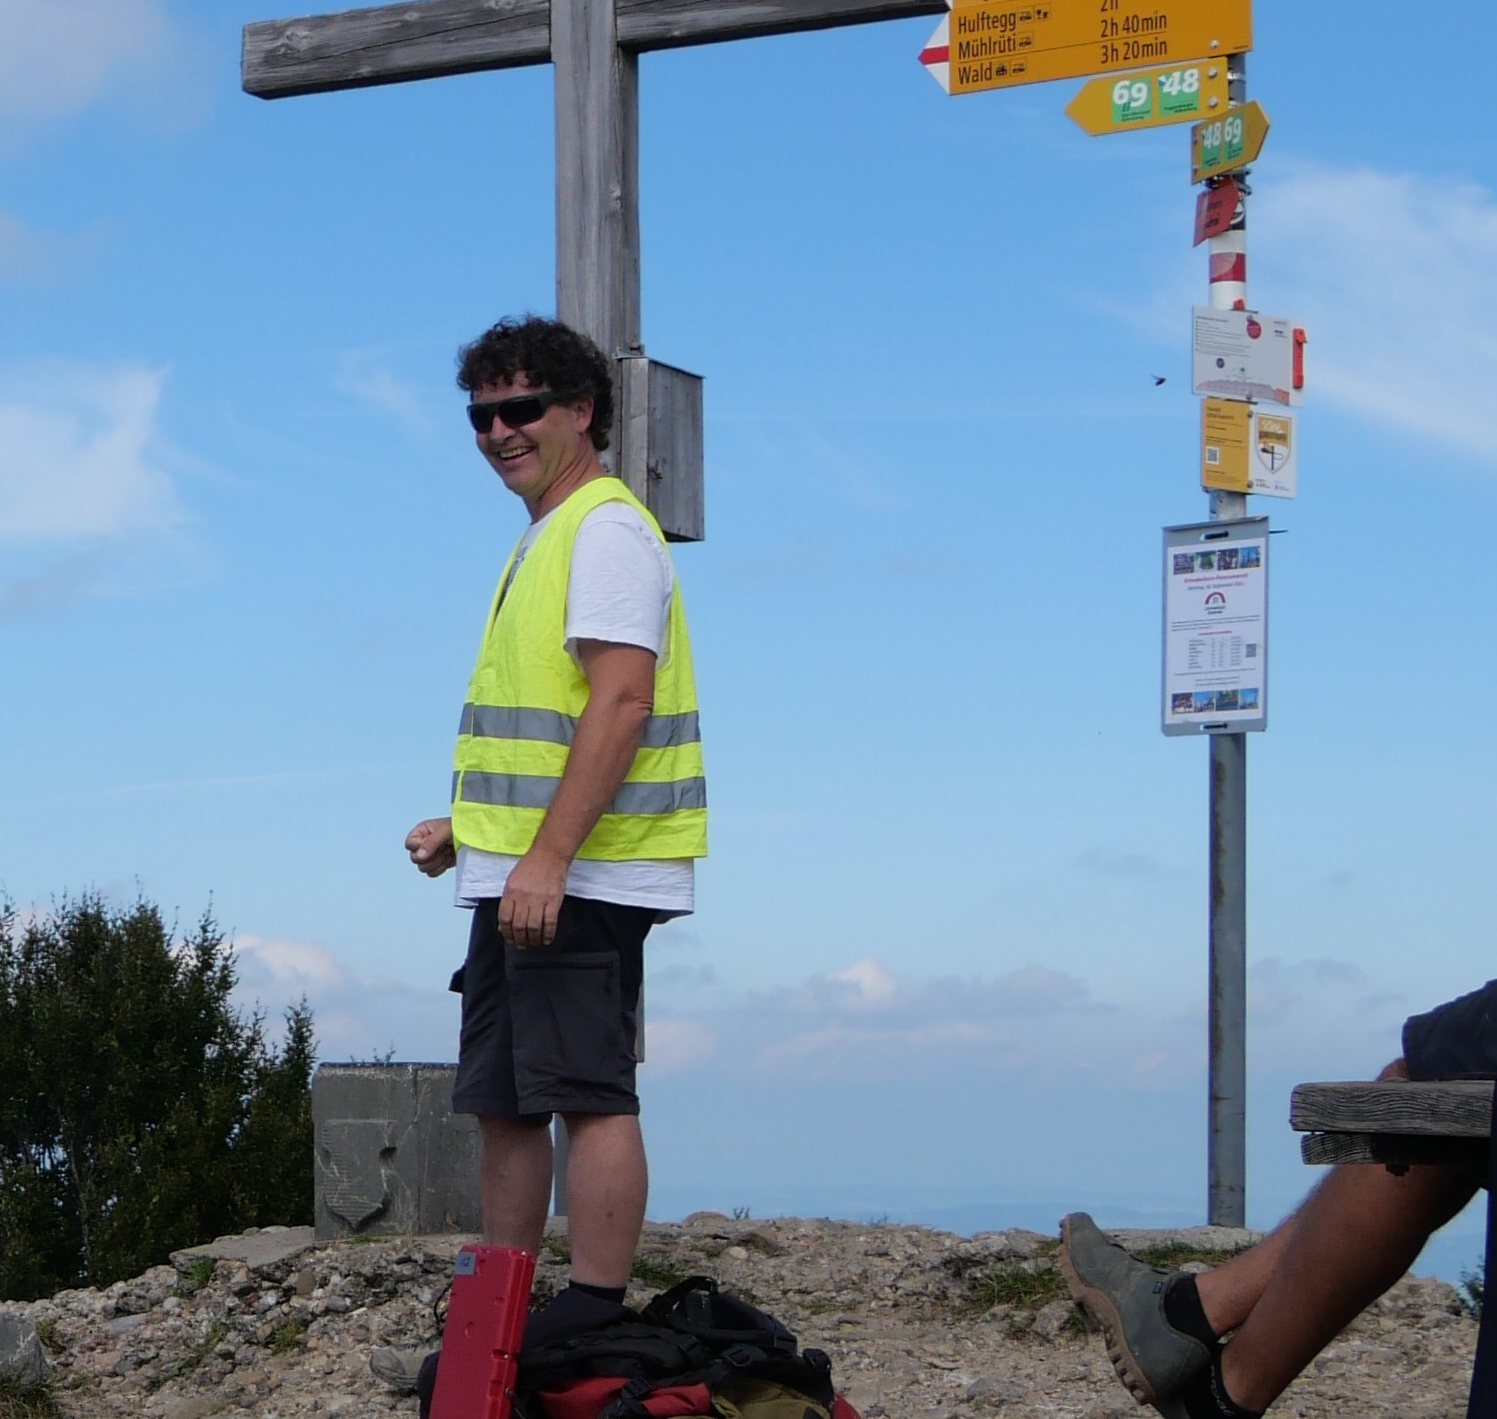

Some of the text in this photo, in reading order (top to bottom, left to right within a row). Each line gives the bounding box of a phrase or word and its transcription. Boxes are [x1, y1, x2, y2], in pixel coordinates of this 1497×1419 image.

[958, 9, 1016, 34] Hulftegg
[1122, 10, 1167, 34] 40min
[958, 33, 1016, 59] Mühlrüti
[1122, 37, 1167, 60] 20min
[958, 62, 993, 85] Wald
[1162, 69, 1199, 96] 48
[1113, 80, 1148, 107] 69
[1204, 122, 1222, 149] 48
[1224, 116, 1242, 144] 69
